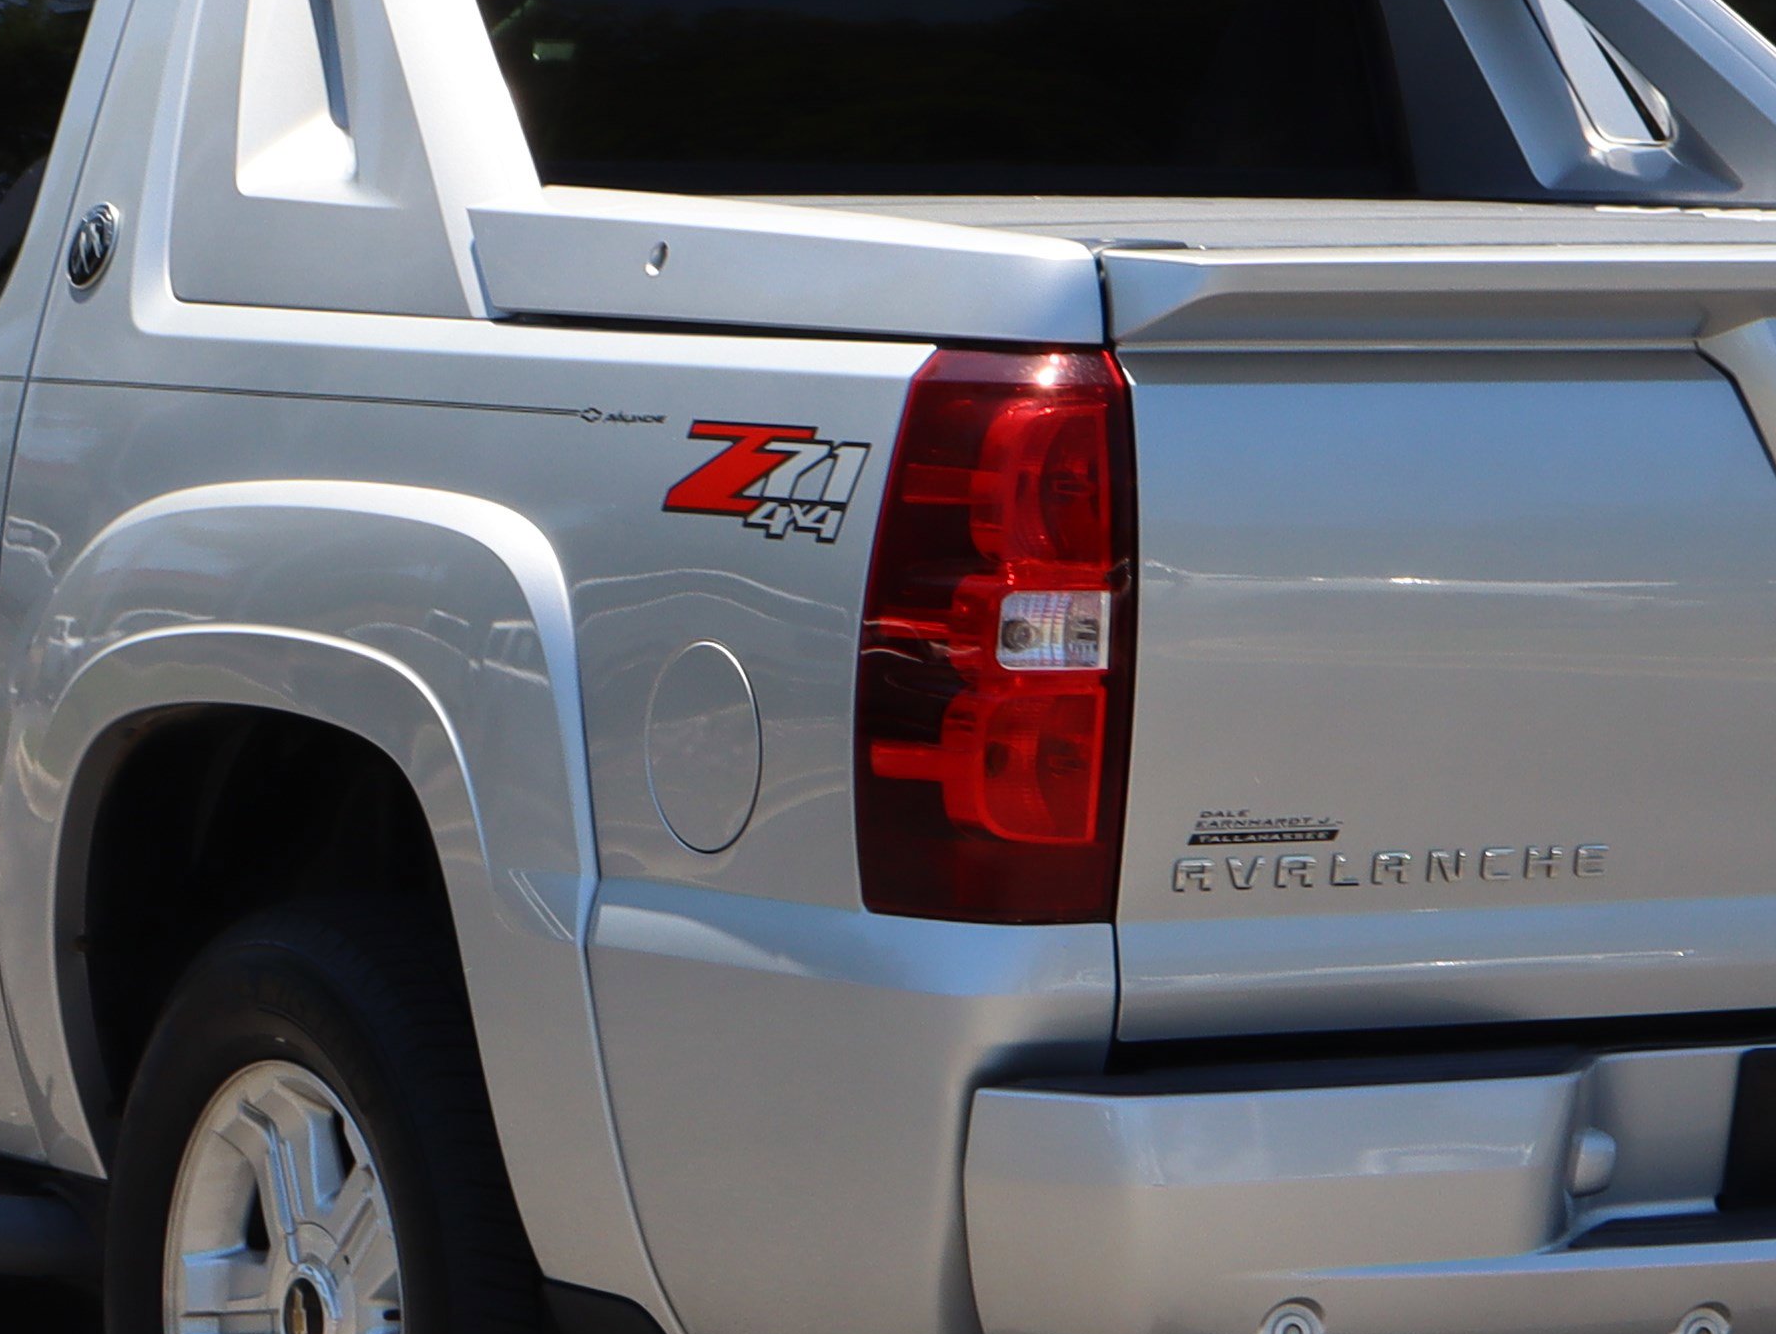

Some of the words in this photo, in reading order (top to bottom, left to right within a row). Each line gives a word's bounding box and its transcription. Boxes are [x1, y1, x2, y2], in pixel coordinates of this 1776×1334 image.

[661, 419, 872, 517] Z71
[1200, 809, 1250, 818] DALE
[1171, 844, 1611, 893] AVALANCHE
